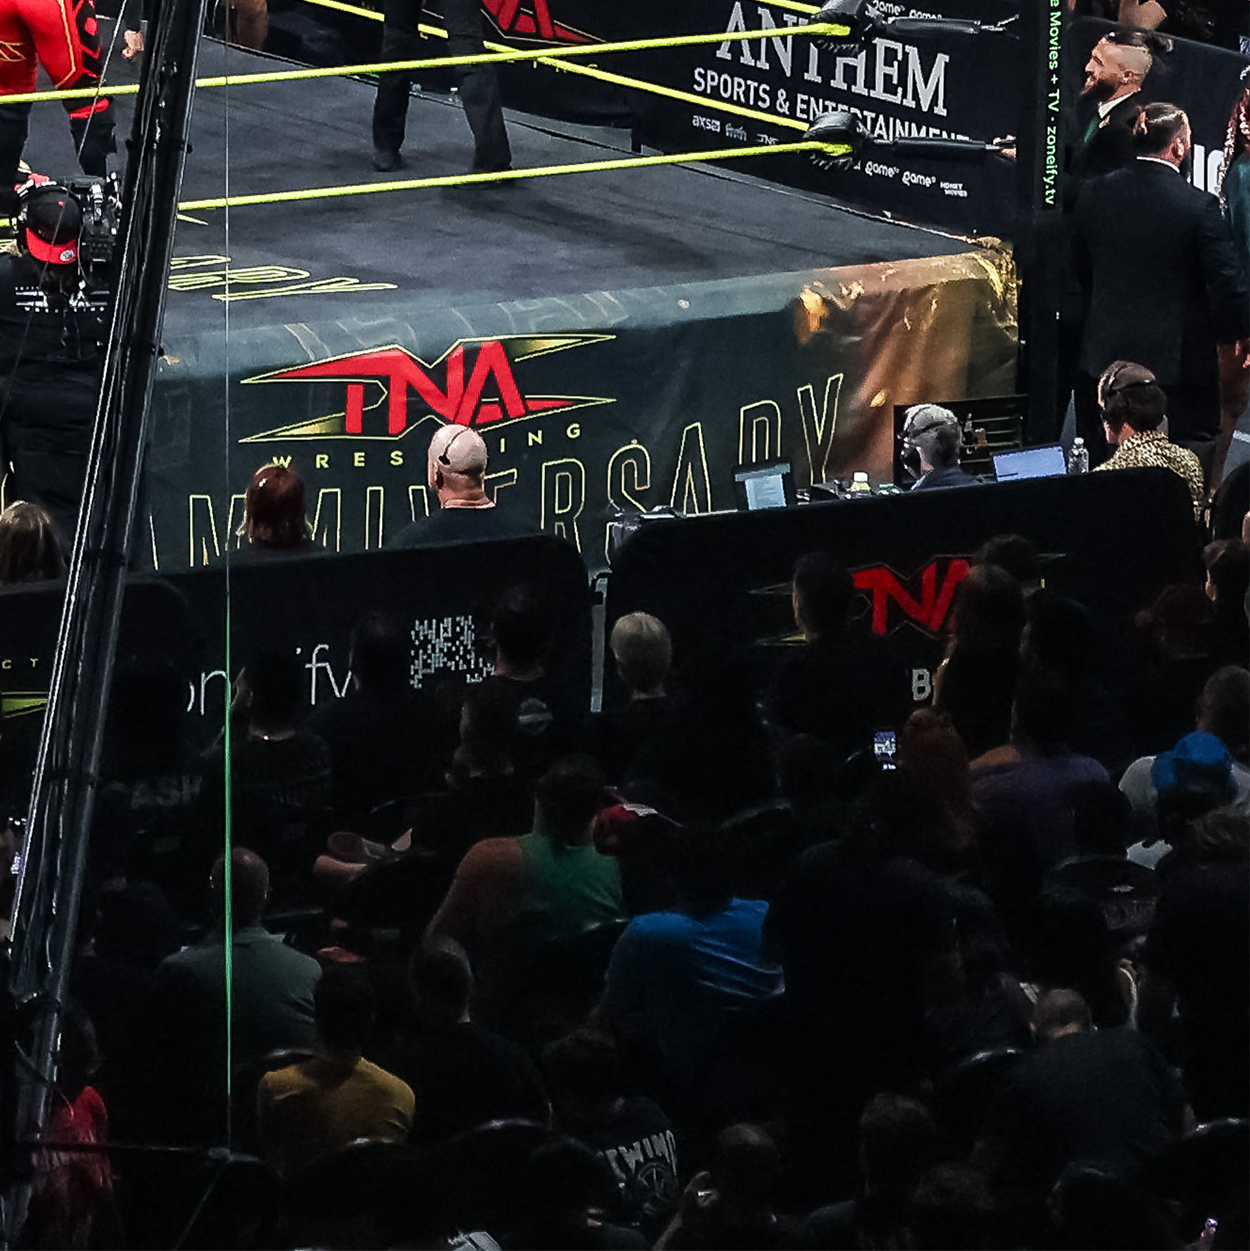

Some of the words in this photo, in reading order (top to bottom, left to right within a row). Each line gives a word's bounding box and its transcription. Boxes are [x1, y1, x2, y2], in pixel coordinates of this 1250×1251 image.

[1048, 10, 1062, 70] Movies
[693, 67, 771, 109] SPORTS
[776, 88, 790, 115] &
[1048, 88, 1060, 112] TV
[1042, 126, 1059, 206] zoneify.tv
[270, 340, 572, 436] TNA
[271, 422, 582, 470] WRESING
